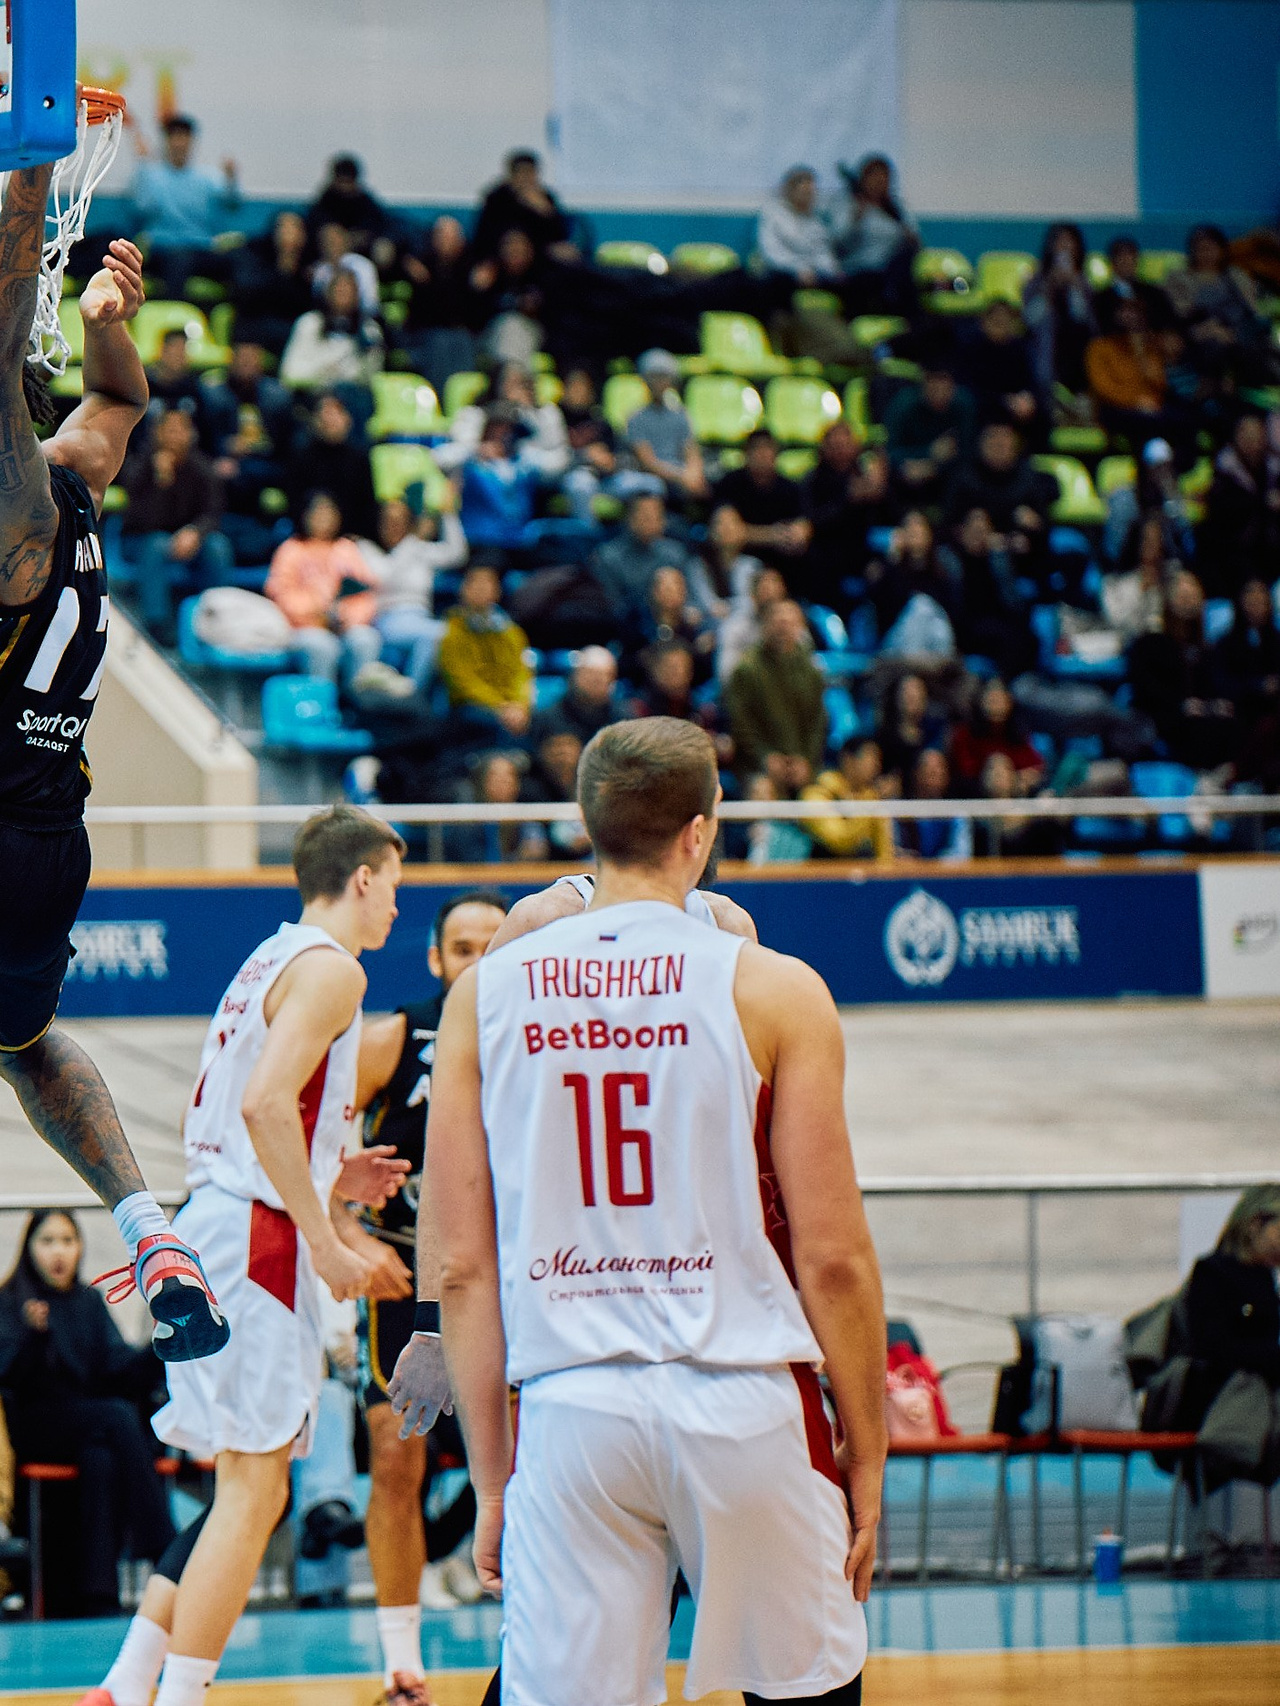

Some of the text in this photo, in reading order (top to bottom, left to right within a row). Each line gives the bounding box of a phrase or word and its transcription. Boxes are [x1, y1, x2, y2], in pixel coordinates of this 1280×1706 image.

[522, 954, 685, 1000] TRUSHKIN
[524, 1019, 689, 1055] BetBoom
[563, 1072, 654, 1206] 16
